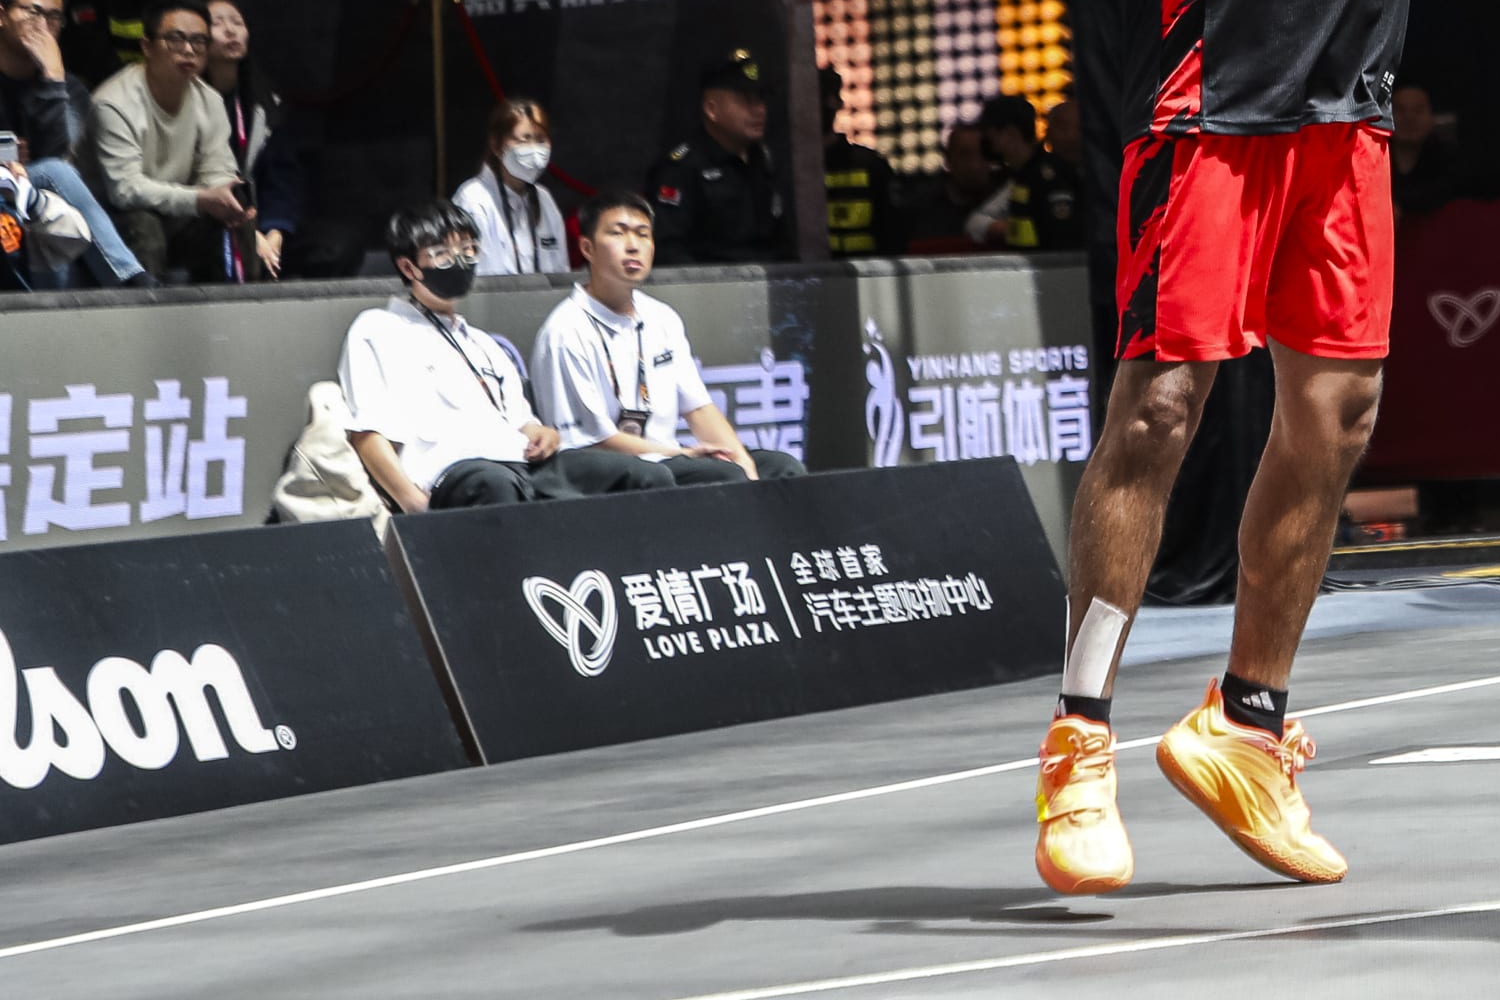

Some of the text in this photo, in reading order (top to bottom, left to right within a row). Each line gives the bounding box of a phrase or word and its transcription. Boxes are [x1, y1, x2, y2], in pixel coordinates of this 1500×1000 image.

[906, 345, 1089, 381] YINHANG SPORTS
[907, 373, 1092, 466] 引航体育
[0, 376, 248, 541] 定站
[621, 560, 767, 630] 爱情广场
[790, 543, 889, 585] 全球首家
[802, 571, 994, 633] 汽车主题购物中心
[643, 621, 780, 660] LOVE PLAZA
